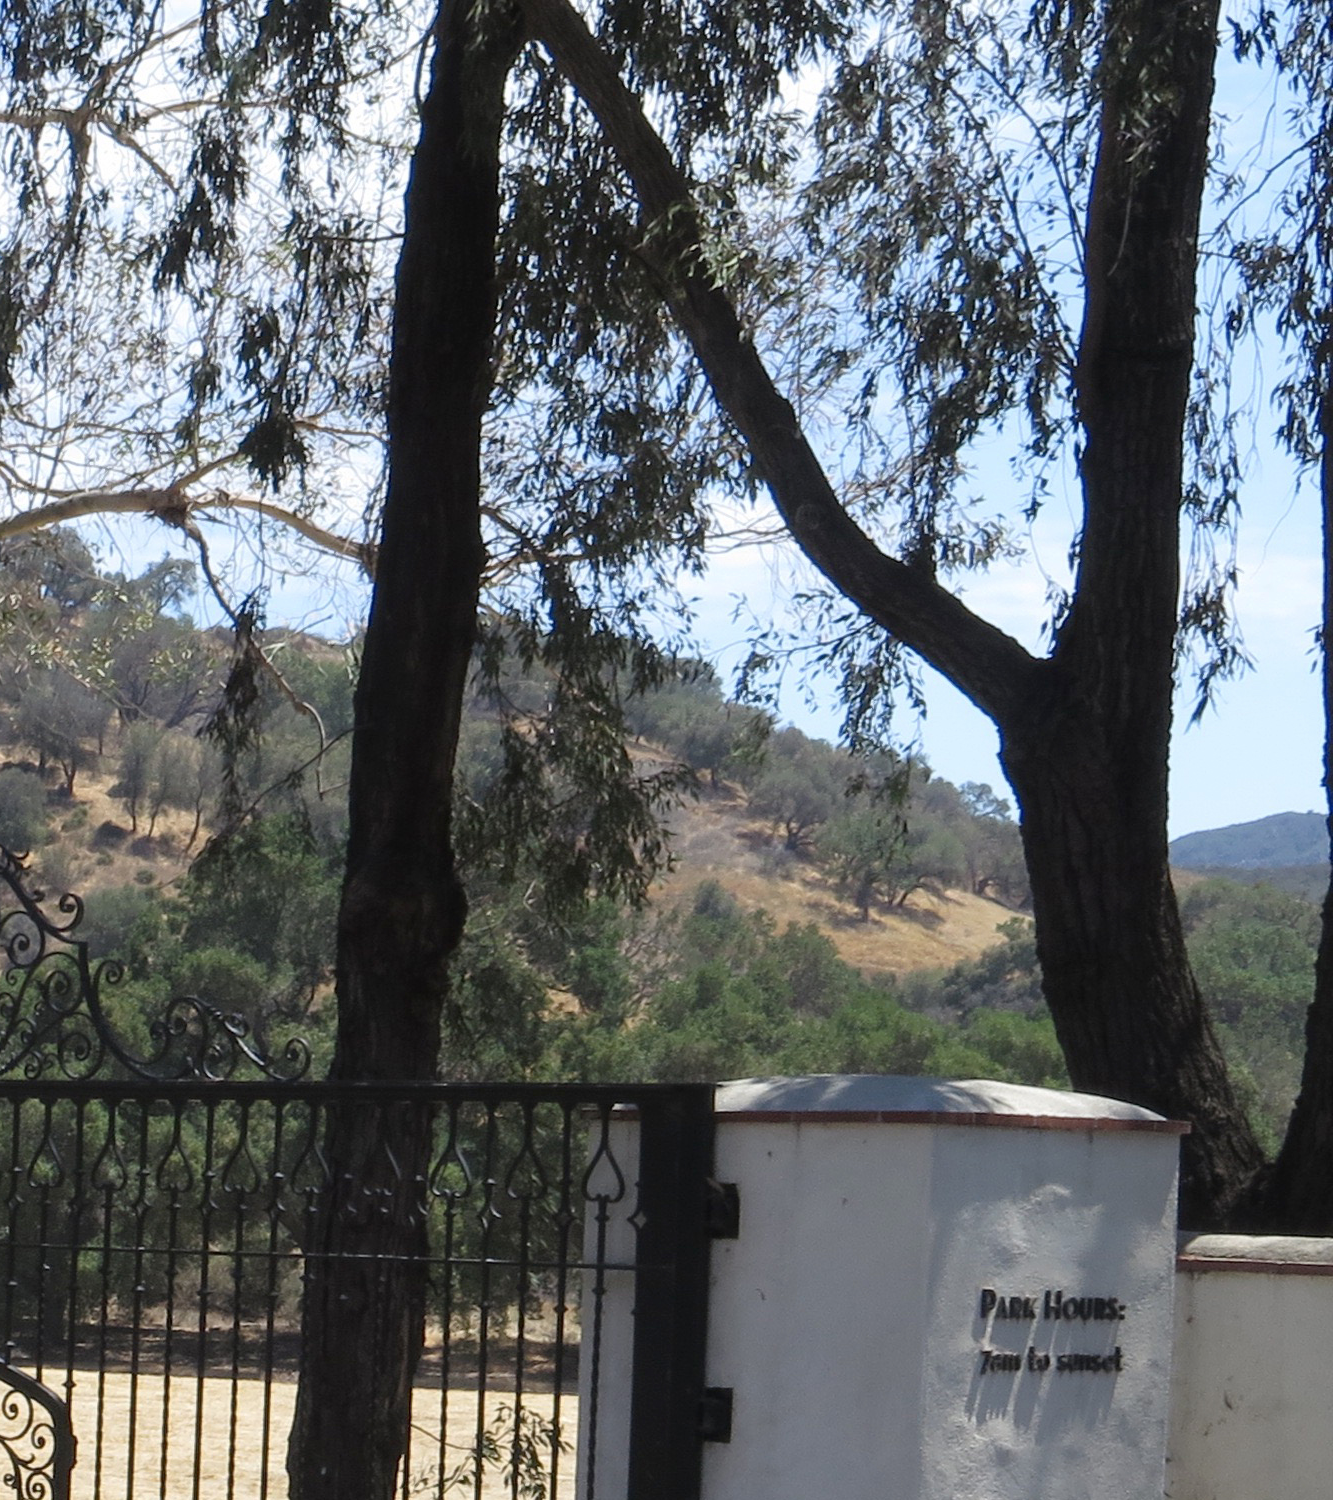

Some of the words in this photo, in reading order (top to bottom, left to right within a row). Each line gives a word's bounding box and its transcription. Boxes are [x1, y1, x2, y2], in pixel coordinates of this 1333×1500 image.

[980, 1288, 1037, 1320] PARK
[1044, 1289, 1126, 1321] HOURS:
[1027, 1346, 1050, 1372] to
[1057, 1346, 1123, 1373] sunset
